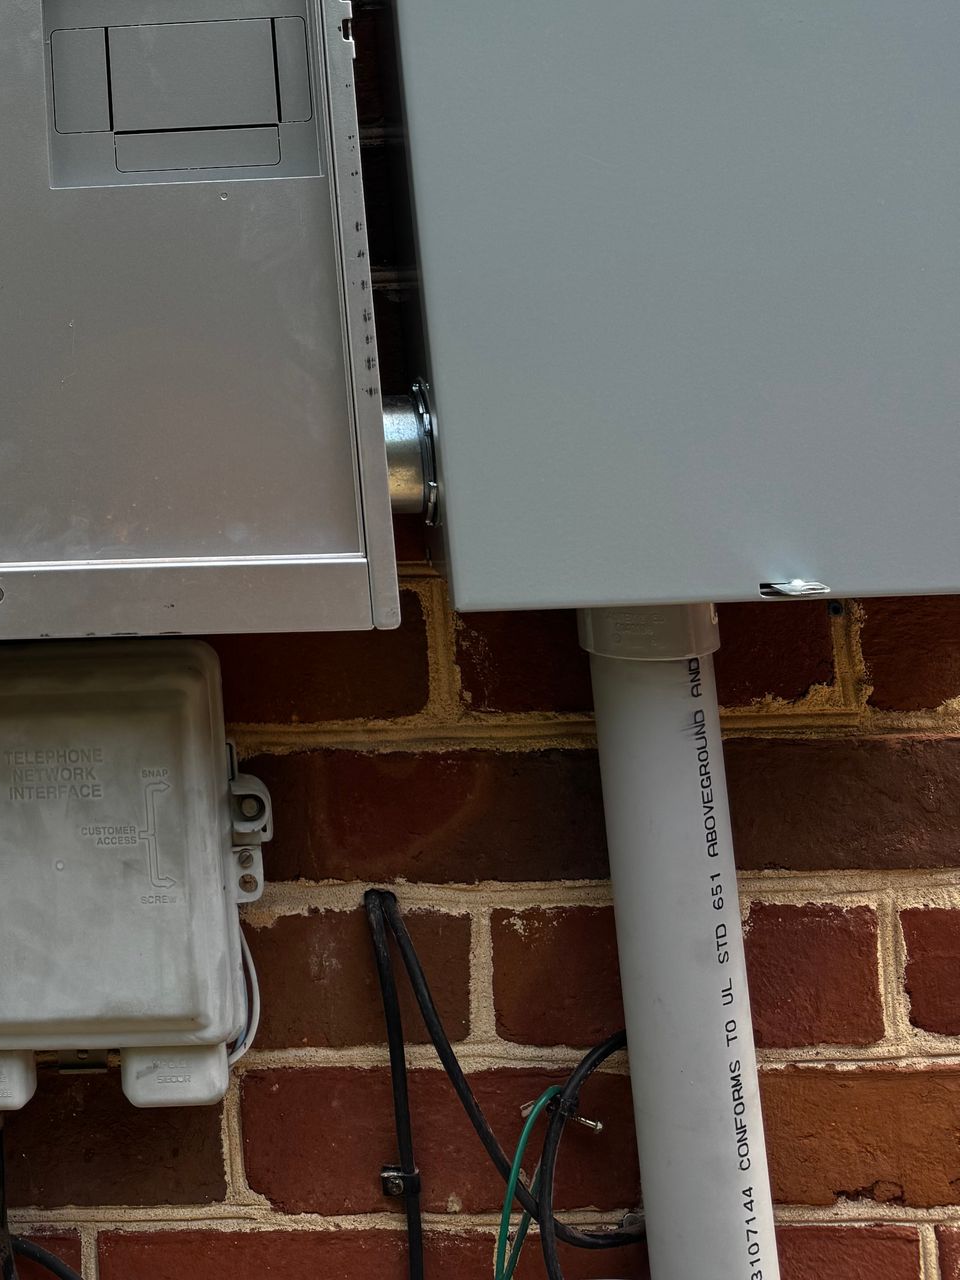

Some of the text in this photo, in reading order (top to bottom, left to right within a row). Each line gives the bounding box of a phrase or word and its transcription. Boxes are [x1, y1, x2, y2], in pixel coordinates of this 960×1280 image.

[688, 658, 702, 697] AND
[4, 749, 103, 765] TELEPHONE
[12, 768, 96, 783] NETWORK
[142, 769, 168, 778] SNAP
[693, 709, 719, 858] ABOVEGROUND
[9, 784, 102, 800] INTERFACE
[81, 826, 136, 836] CUSTOMER
[97, 836, 137, 846] ACCESS
[140, 895, 177, 904] SCREW
[709, 872, 724, 910] 651
[716, 923, 729, 964] STD
[722, 977, 734, 1006] UL
[726, 1019, 737, 1047] TO
[729, 1060, 752, 1170] CONFORMS
